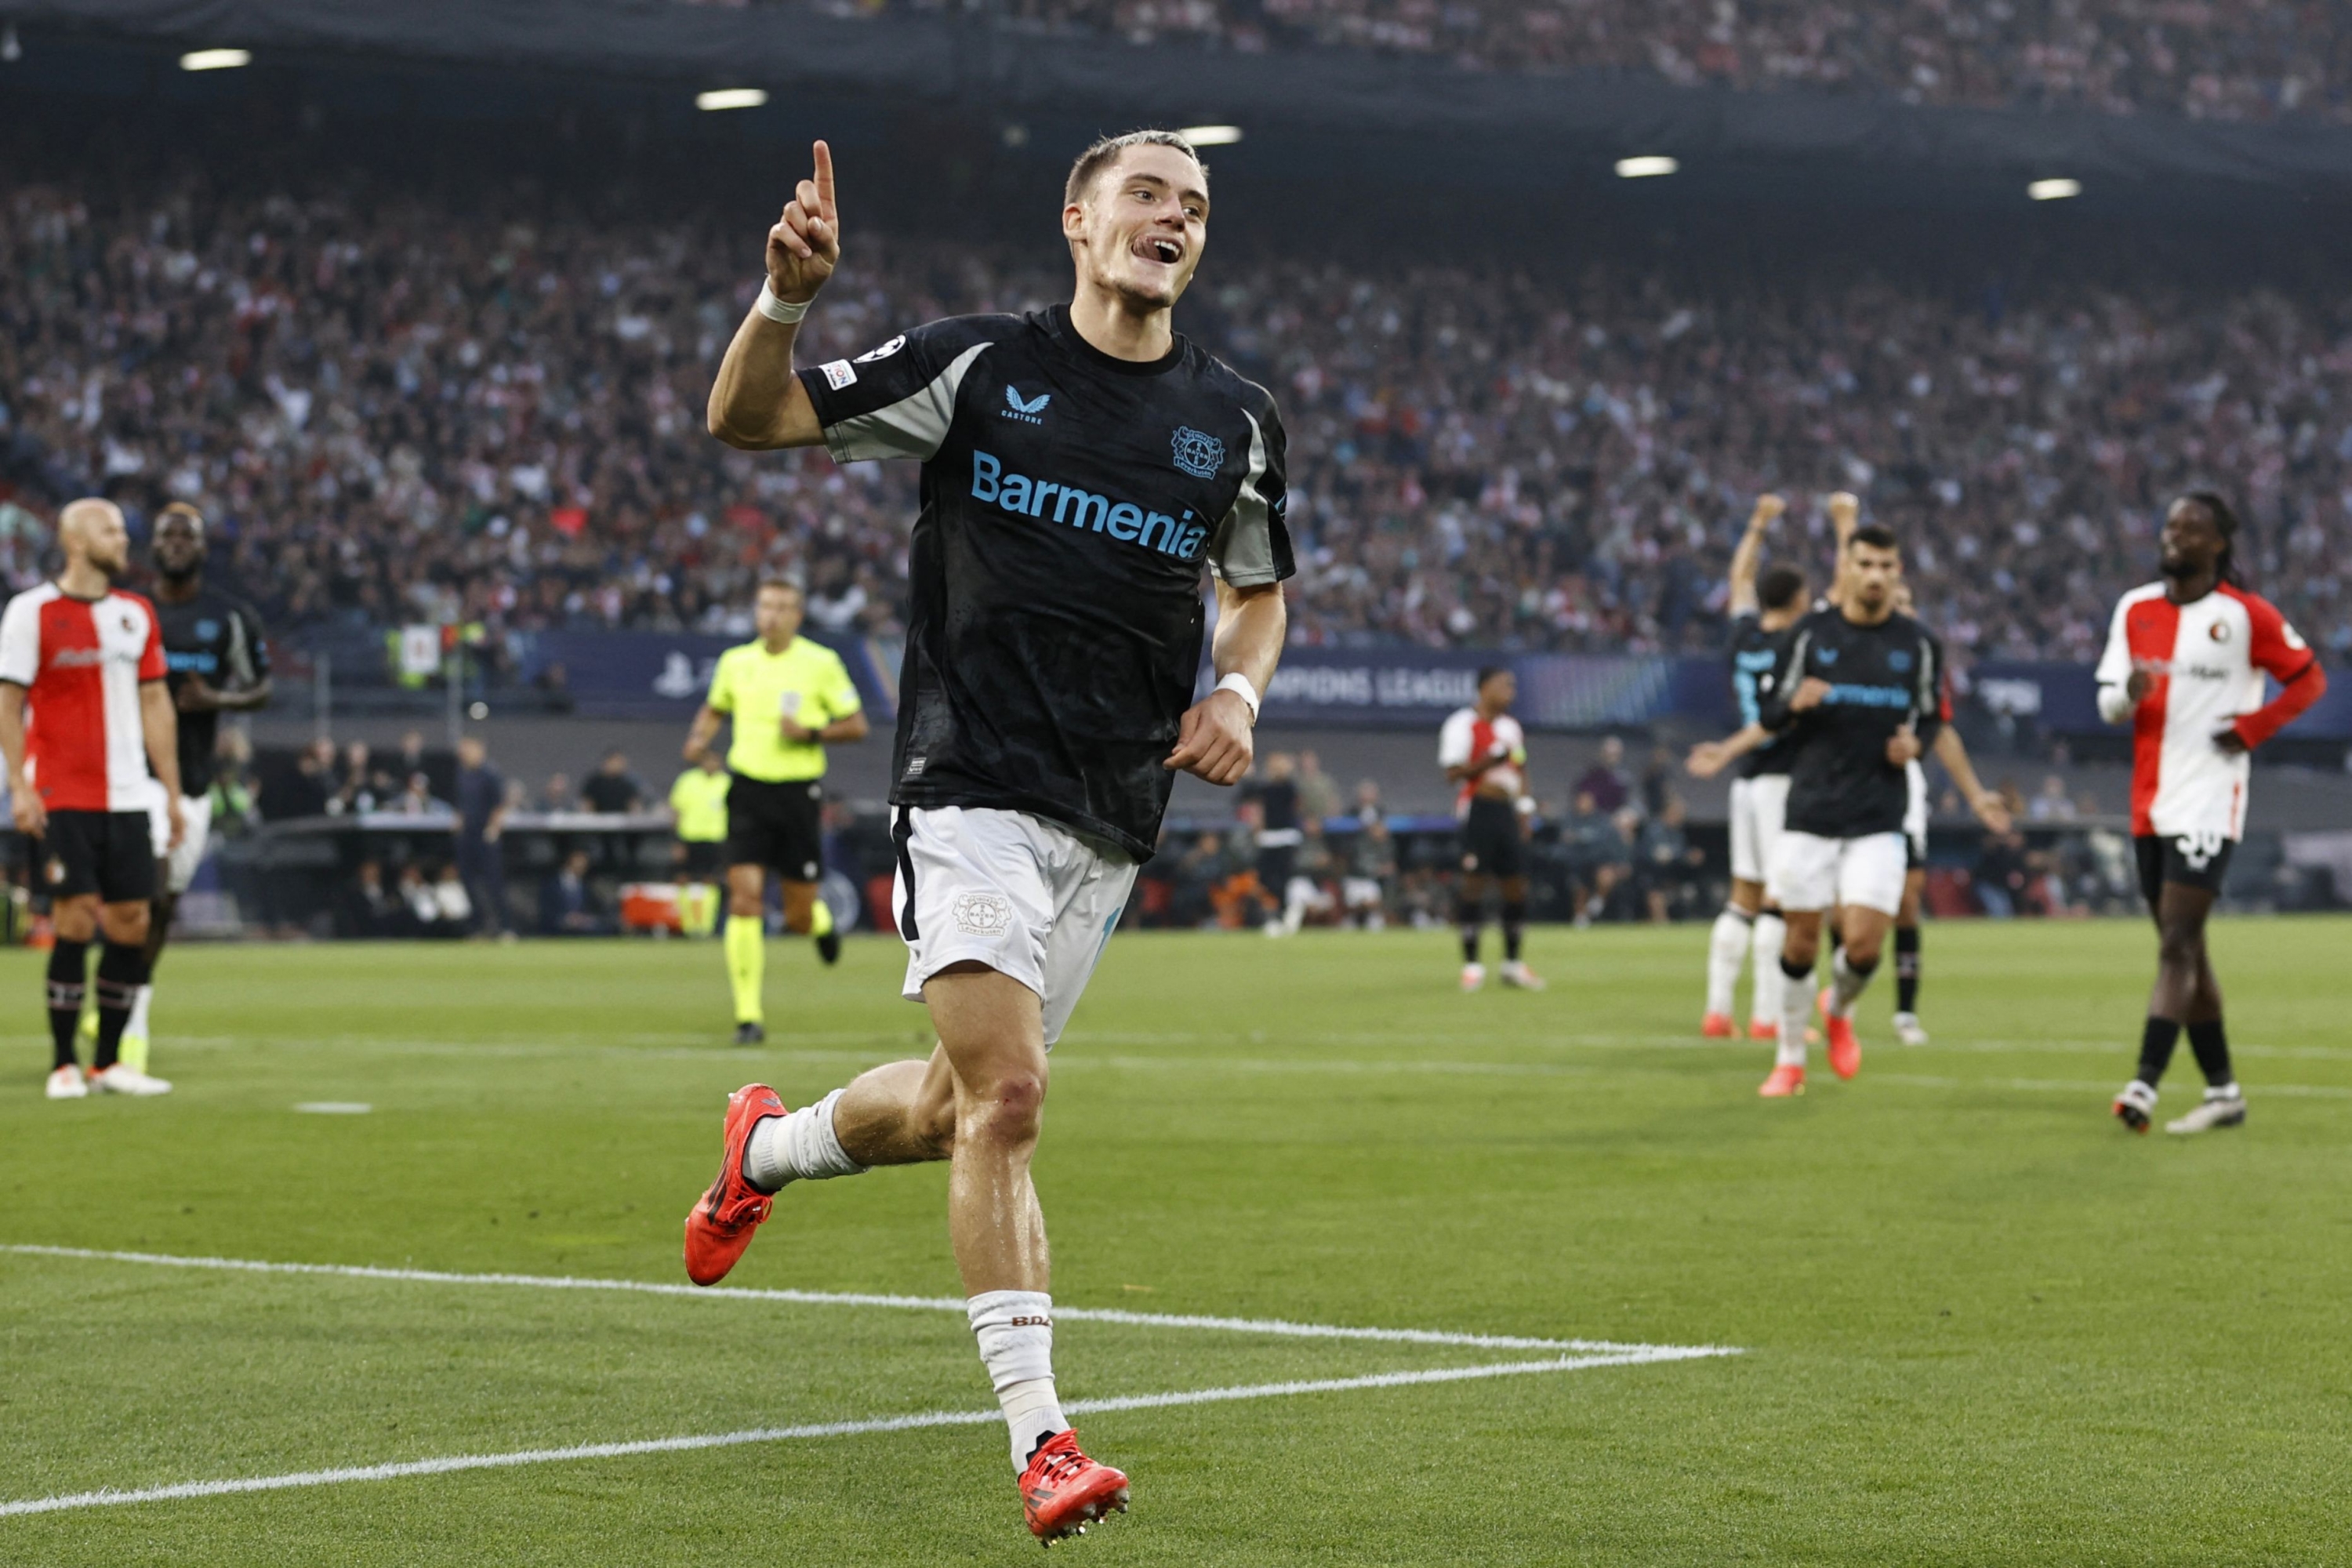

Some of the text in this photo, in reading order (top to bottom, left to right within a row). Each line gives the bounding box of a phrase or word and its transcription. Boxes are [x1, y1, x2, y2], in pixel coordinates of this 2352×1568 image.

[1001, 410, 1042, 425] CASTORE
[1187, 448, 1208, 459] BAYER
[1177, 459, 1212, 477] Leverkusen
[971, 449, 1207, 558] Barmenia
[961, 925, 1001, 935] Leverkusen
